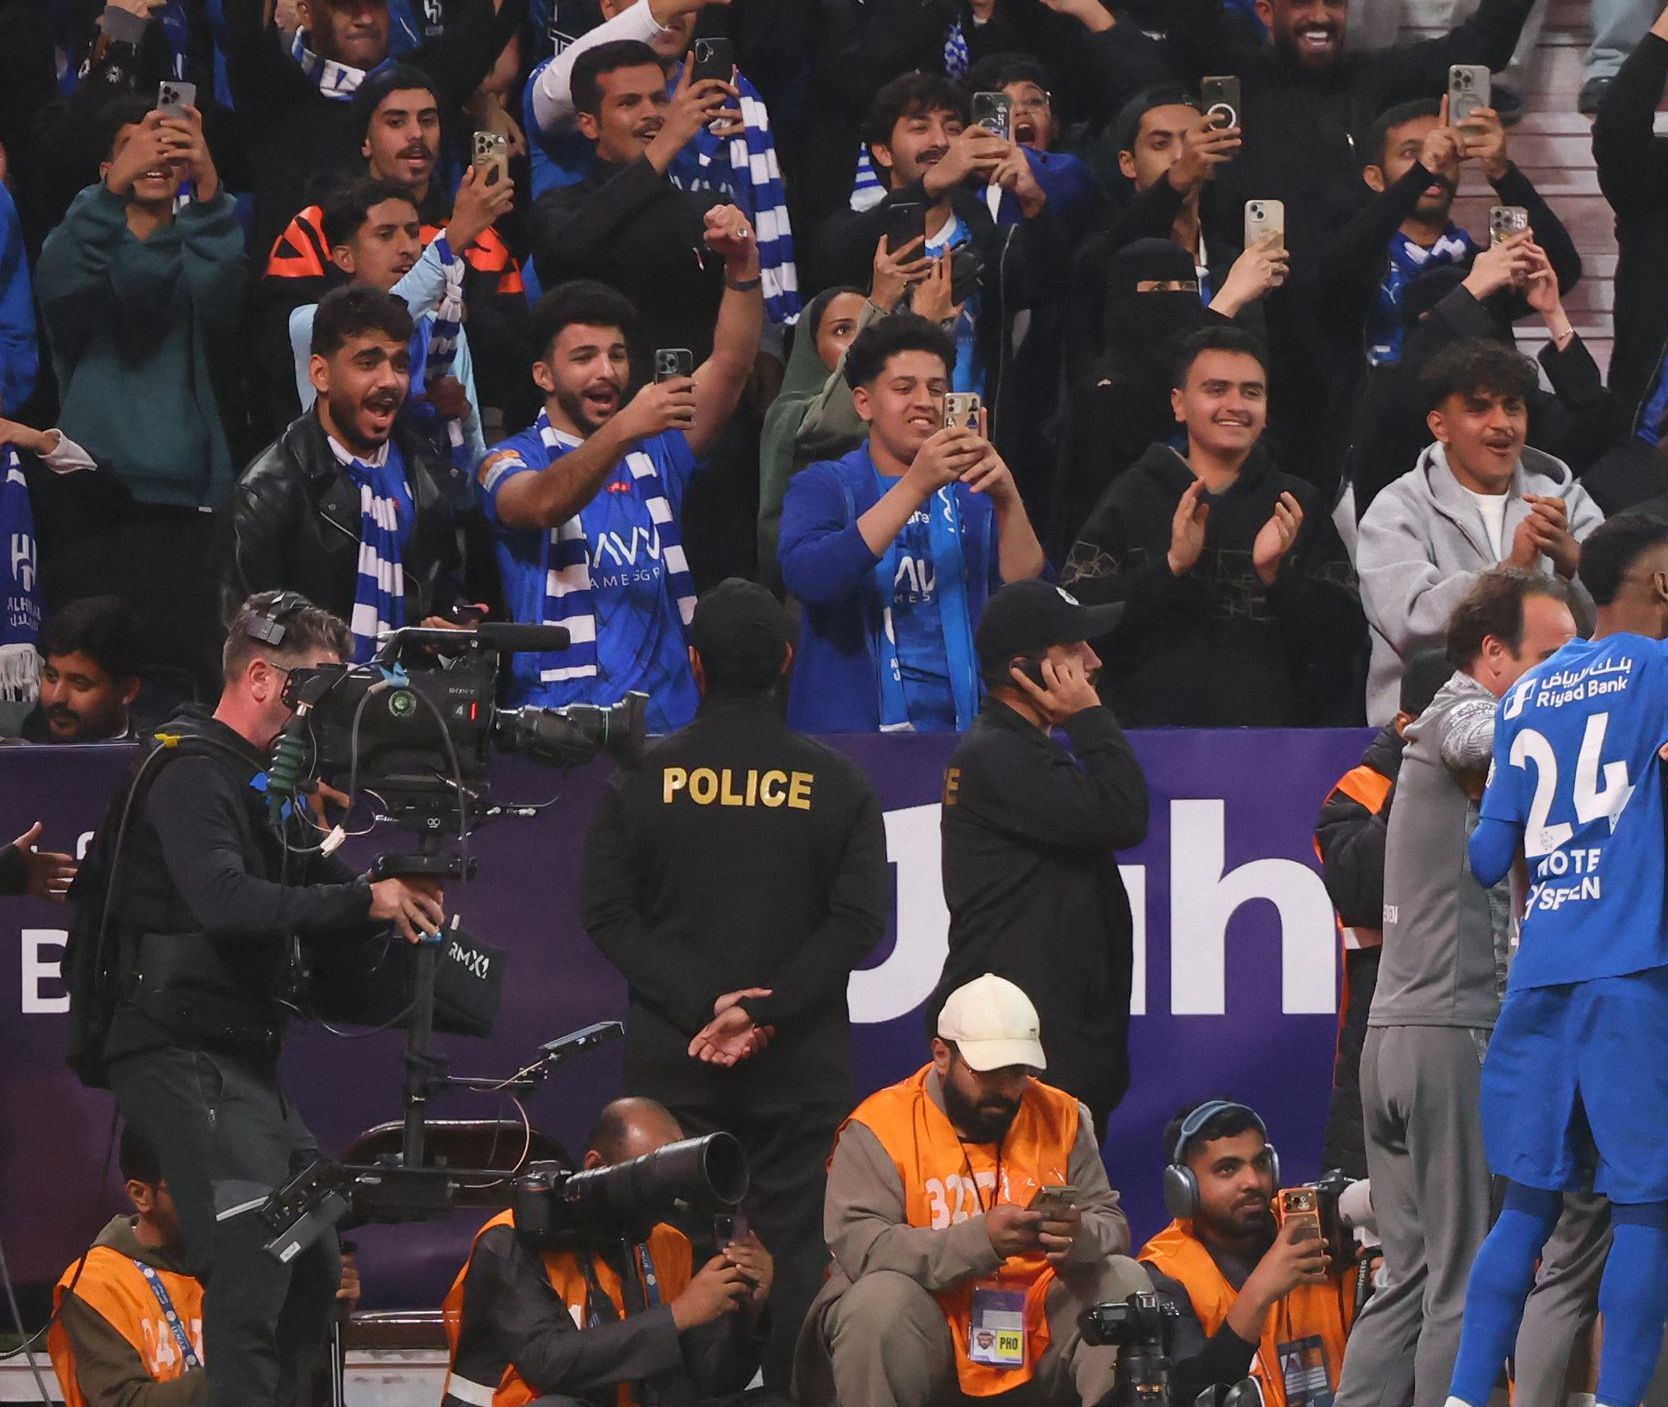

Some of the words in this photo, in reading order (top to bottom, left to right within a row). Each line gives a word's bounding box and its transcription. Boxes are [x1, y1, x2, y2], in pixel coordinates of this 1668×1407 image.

[455, 704, 464, 717] 4
[1536, 683, 1585, 709] Riyad
[1587, 676, 1629, 700] Bank
[662, 767, 815, 811] POLICE
[1509, 712, 1635, 859] 24
